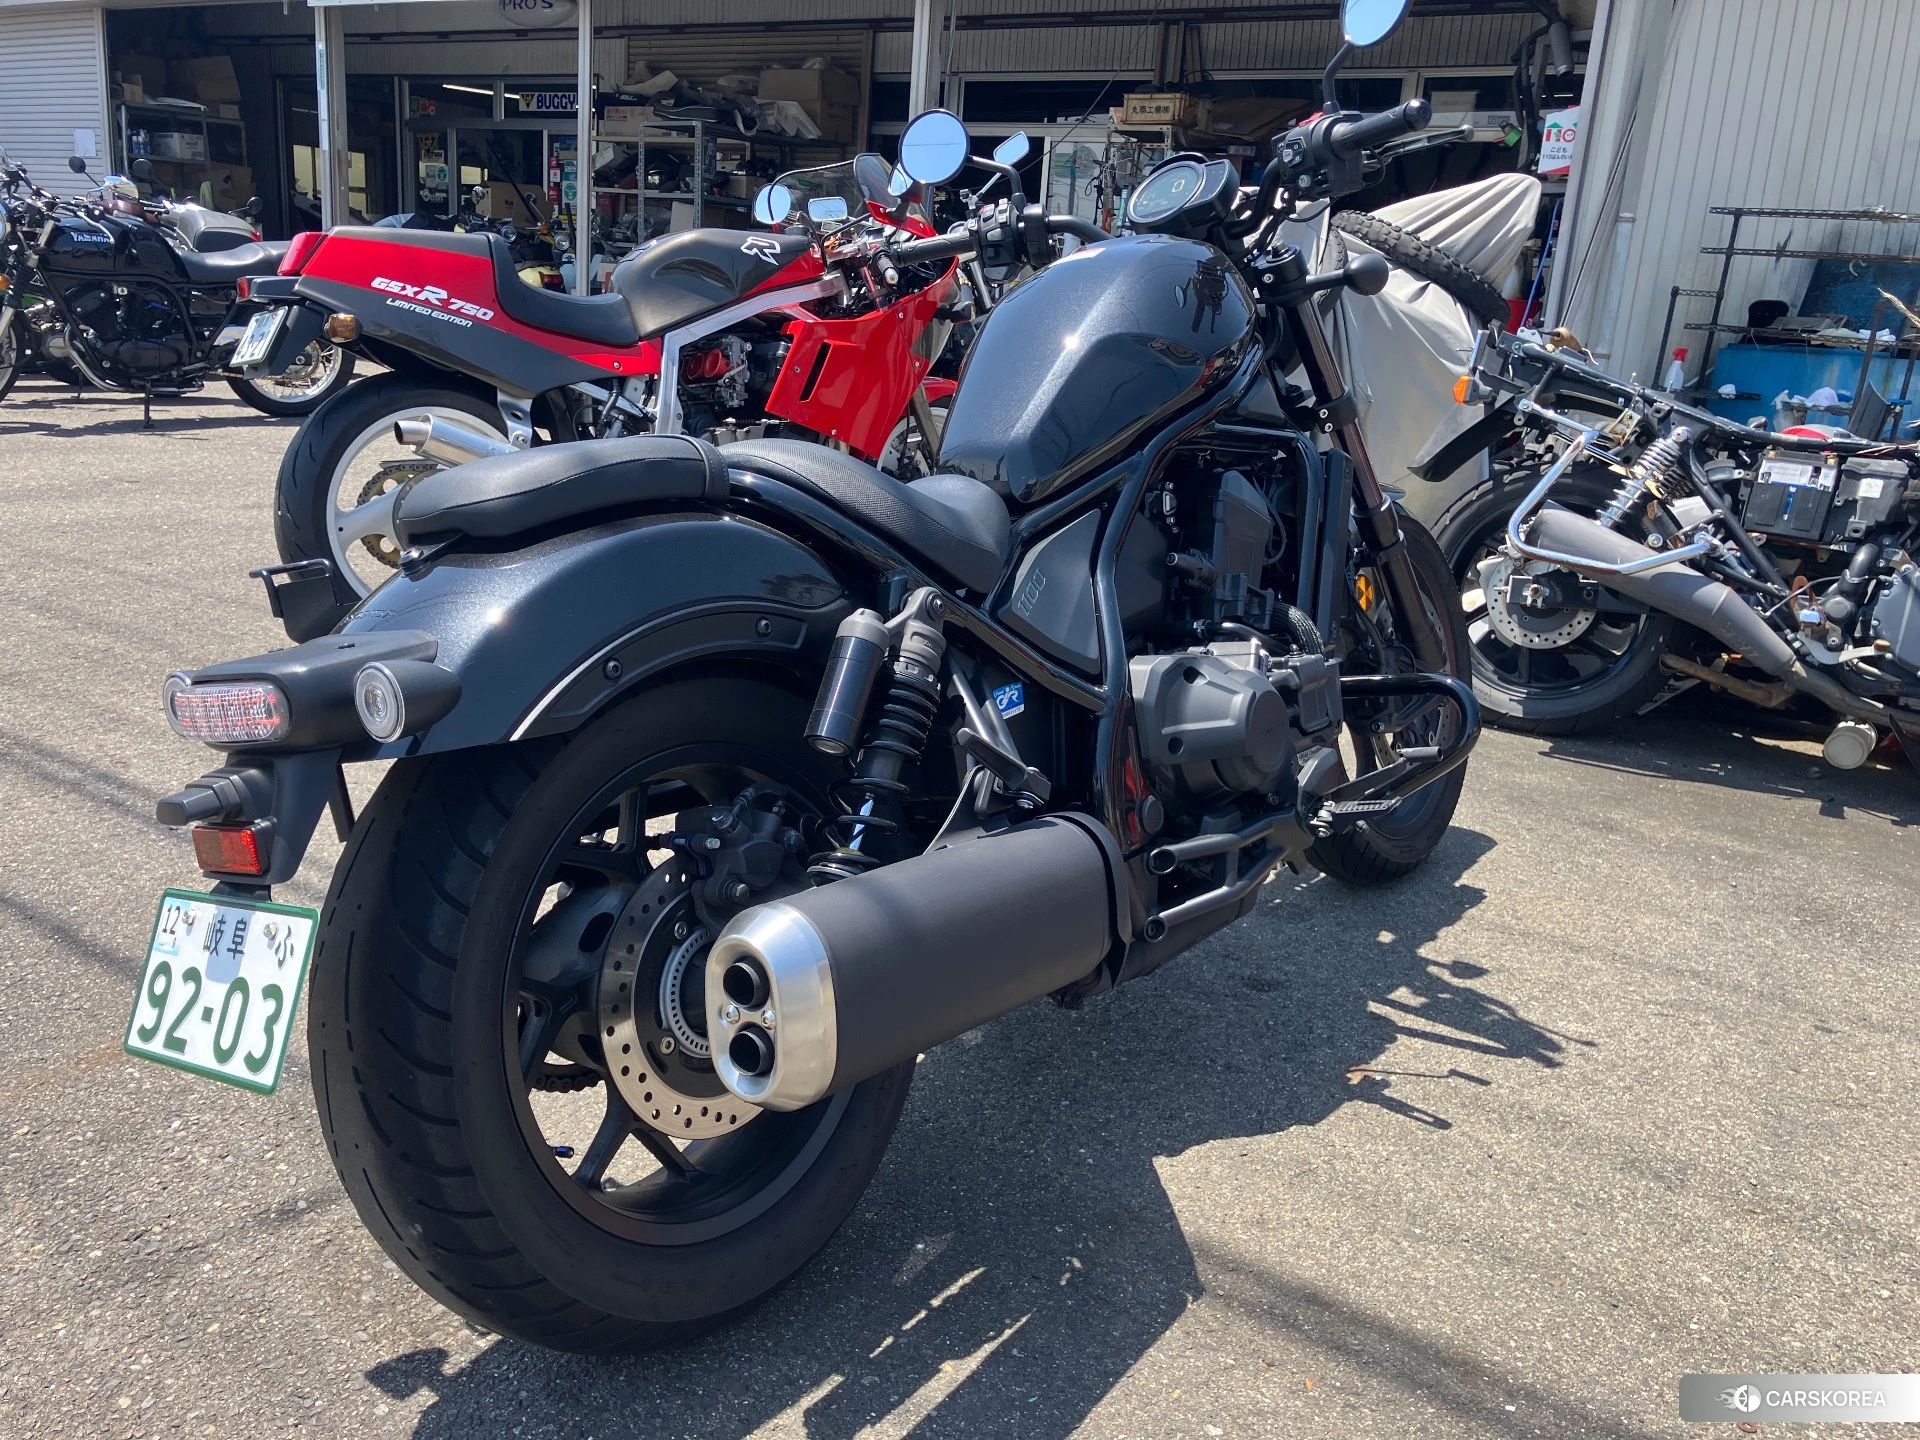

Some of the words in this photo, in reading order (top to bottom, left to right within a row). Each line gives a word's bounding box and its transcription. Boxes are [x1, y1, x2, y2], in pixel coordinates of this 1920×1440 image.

[536, 93, 576, 110] BUGGY
[385, 297, 432, 315] LIMITED
[431, 310, 473, 328] EDITION
[448, 298, 495, 321] 750
[161, 903, 181, 935] 12
[202, 912, 248, 960] 岐阜
[274, 924, 295, 970] ふ
[136, 960, 284, 1075] 92-03
